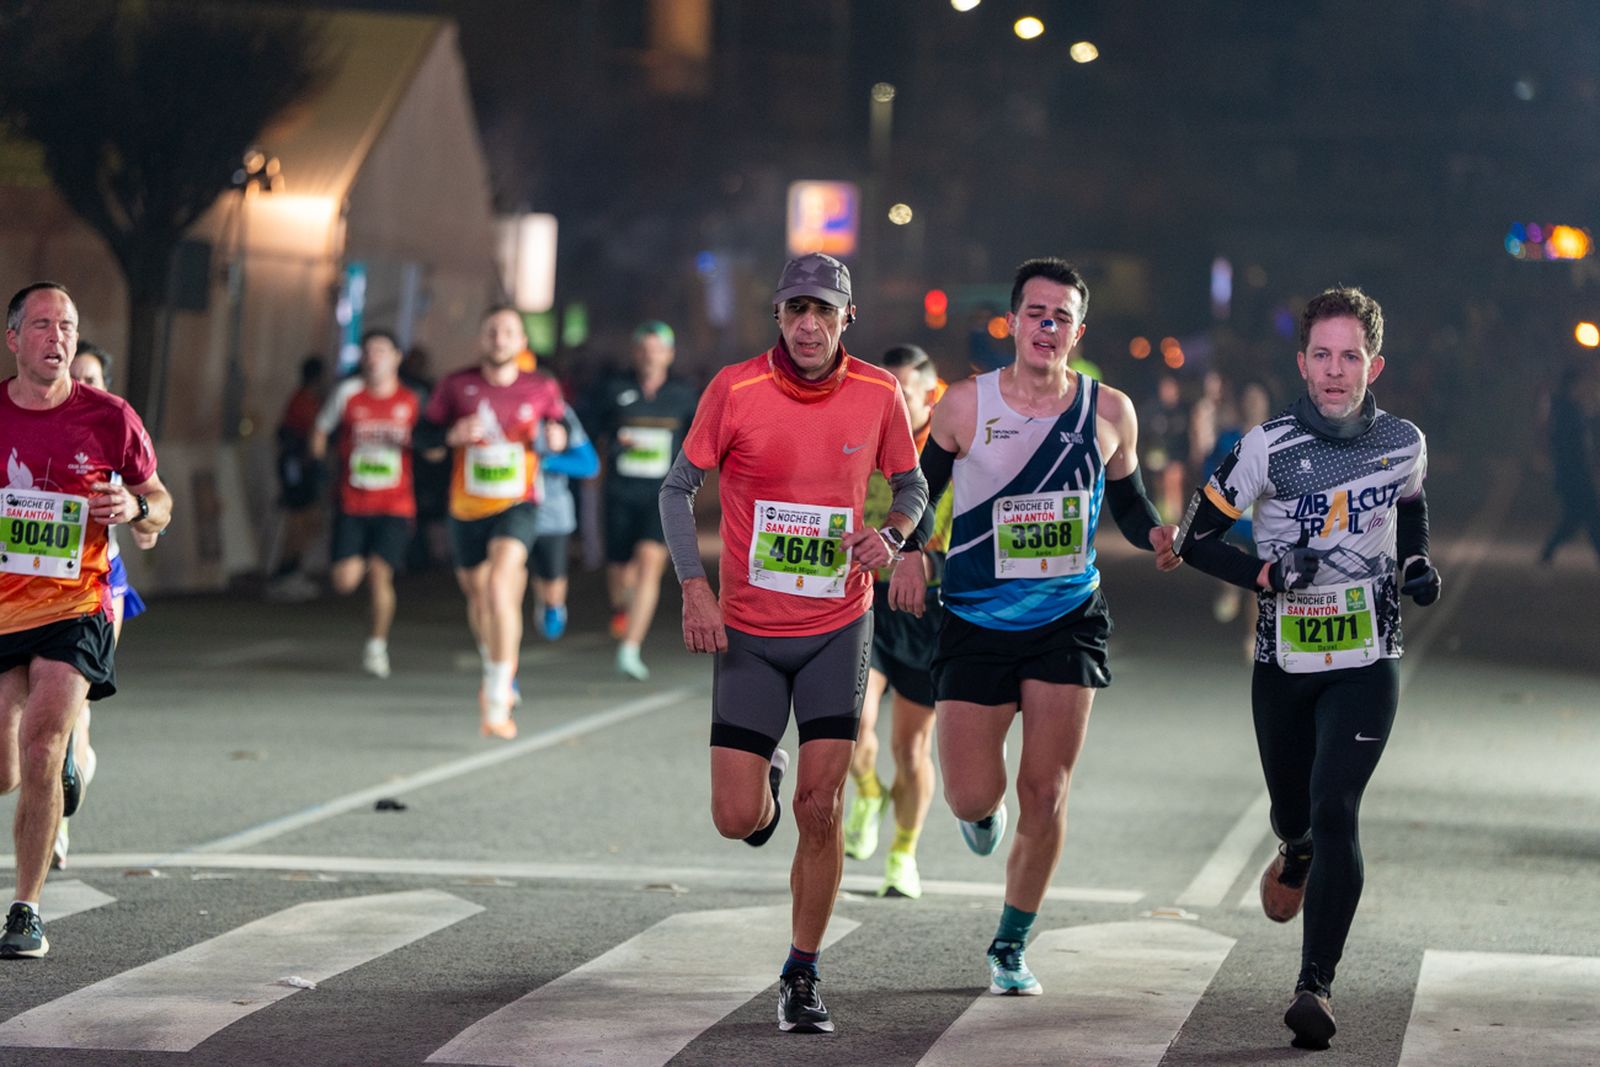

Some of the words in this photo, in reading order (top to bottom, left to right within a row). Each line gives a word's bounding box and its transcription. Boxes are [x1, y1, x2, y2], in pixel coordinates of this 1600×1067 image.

[44, 502, 55, 510] DE
[1013, 502, 1041, 512] NOCHE
[1043, 501, 1055, 510] DE
[6, 508, 22, 517] SAN
[777, 513, 808, 523] NOCHE
[809, 516, 821, 525] DE
[765, 522, 785, 533] SAN
[11, 519, 70, 549] 9040
[1011, 522, 1072, 550] 3368
[769, 536, 836, 567] 4646
[1296, 596, 1325, 605] NOCHE
[1326, 595, 1337, 604] DE
[1287, 606, 1305, 616] SAN
[1306, 603, 1338, 616] ANTÓN
[1295, 614, 1358, 643] 12171
